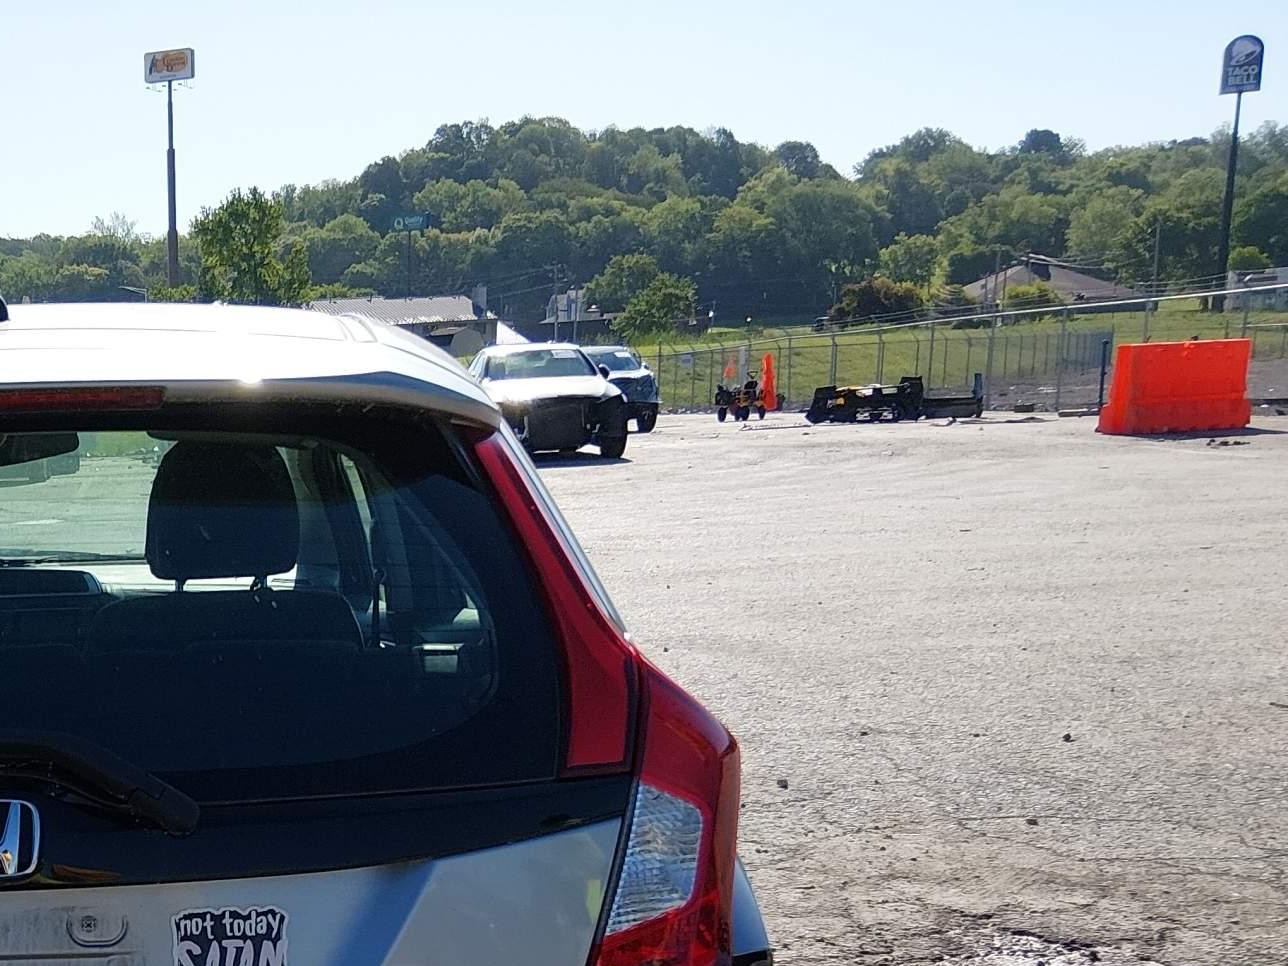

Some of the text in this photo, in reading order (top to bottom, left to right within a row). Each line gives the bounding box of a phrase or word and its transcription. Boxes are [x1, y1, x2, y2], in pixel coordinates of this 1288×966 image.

[1228, 64, 1258, 76] TACO
[1228, 74, 1257, 86] BELL
[179, 910, 281, 939] not today
